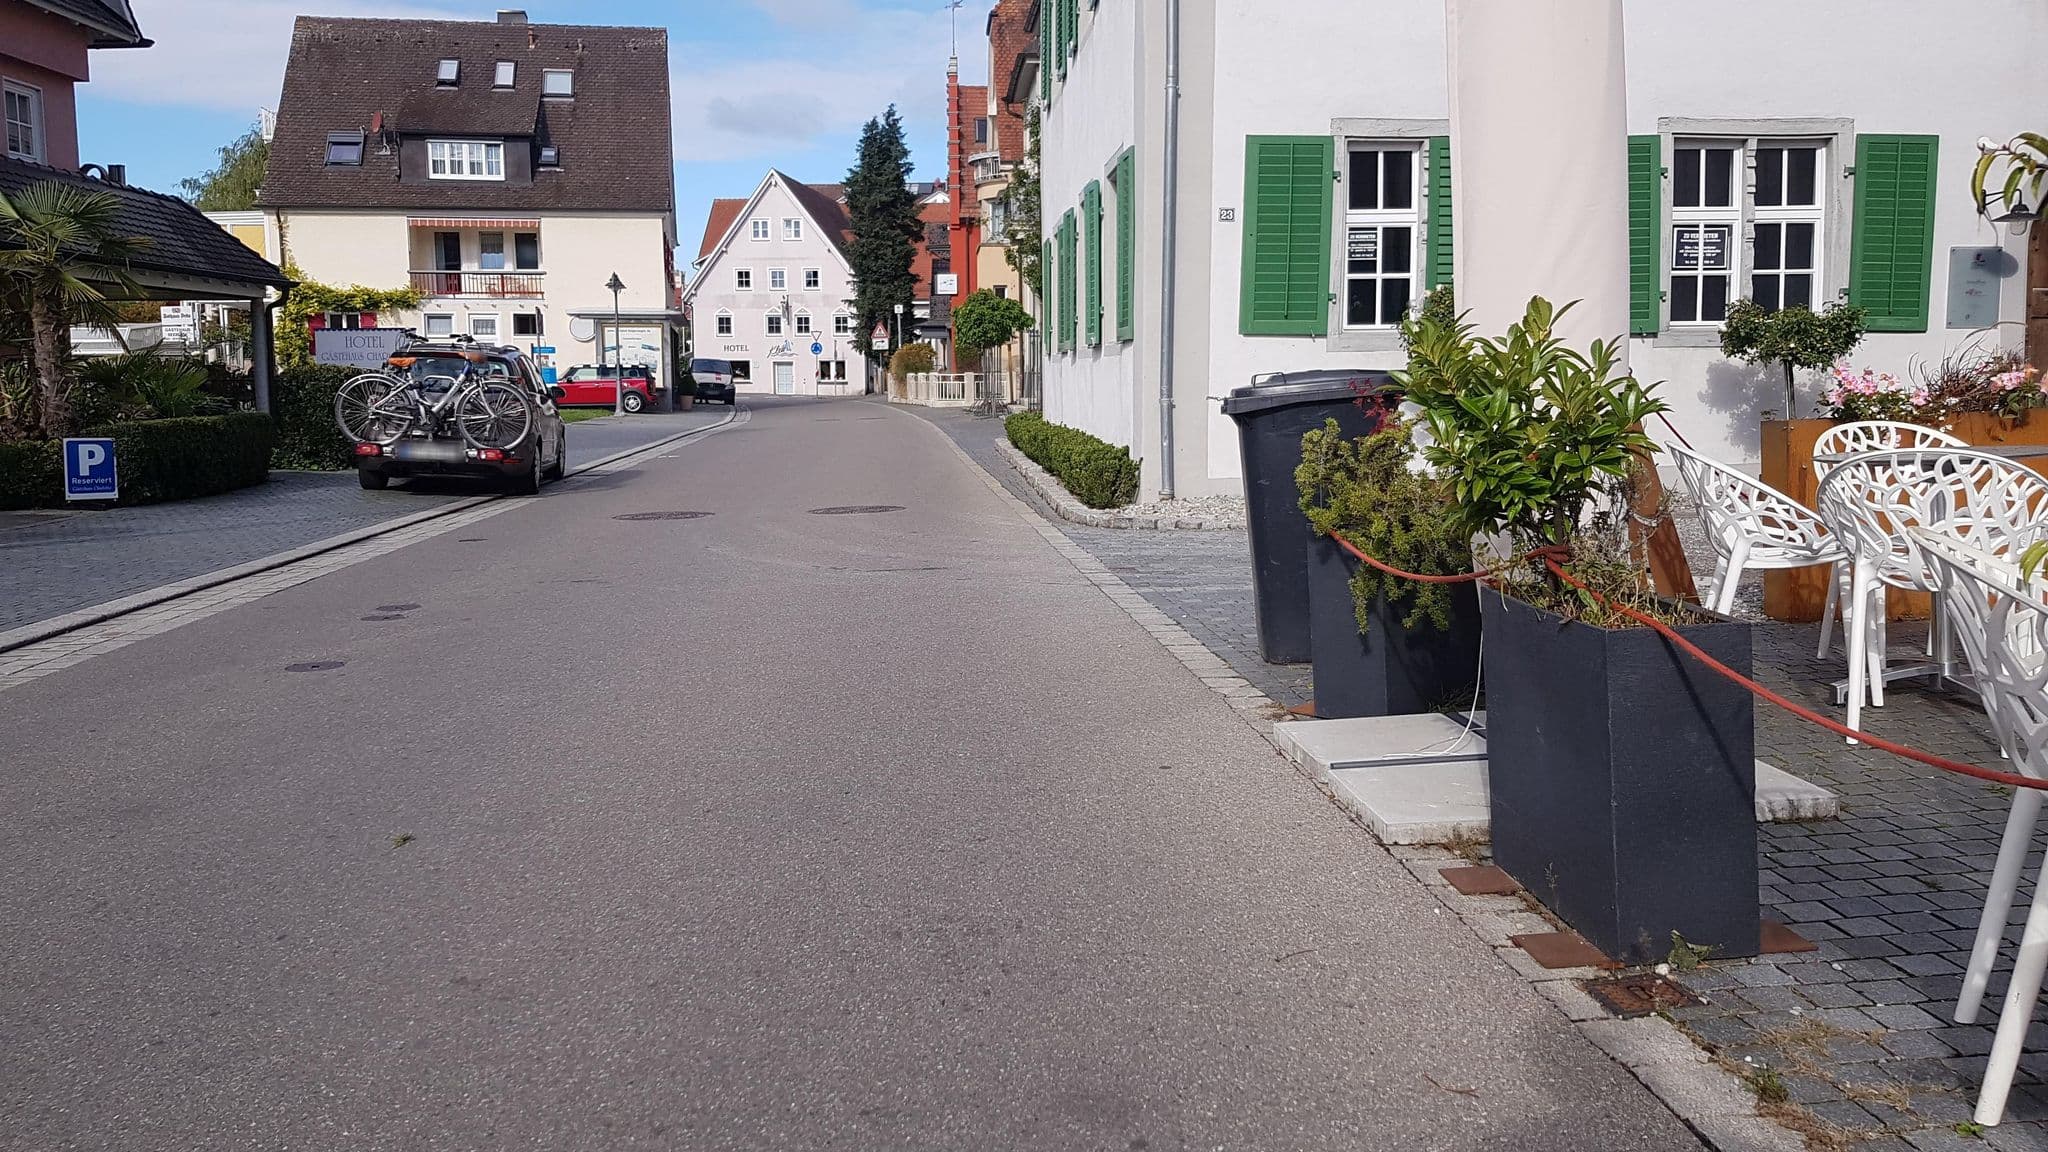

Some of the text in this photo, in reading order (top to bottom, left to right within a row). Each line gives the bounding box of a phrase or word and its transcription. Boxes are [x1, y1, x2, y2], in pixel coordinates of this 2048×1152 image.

[1221, 209, 1233, 220] 23
[345, 335, 384, 348] HOTEL
[723, 344, 750, 352] HOTEL
[79, 444, 105, 476] P
[71, 477, 112, 485] Reserviert
